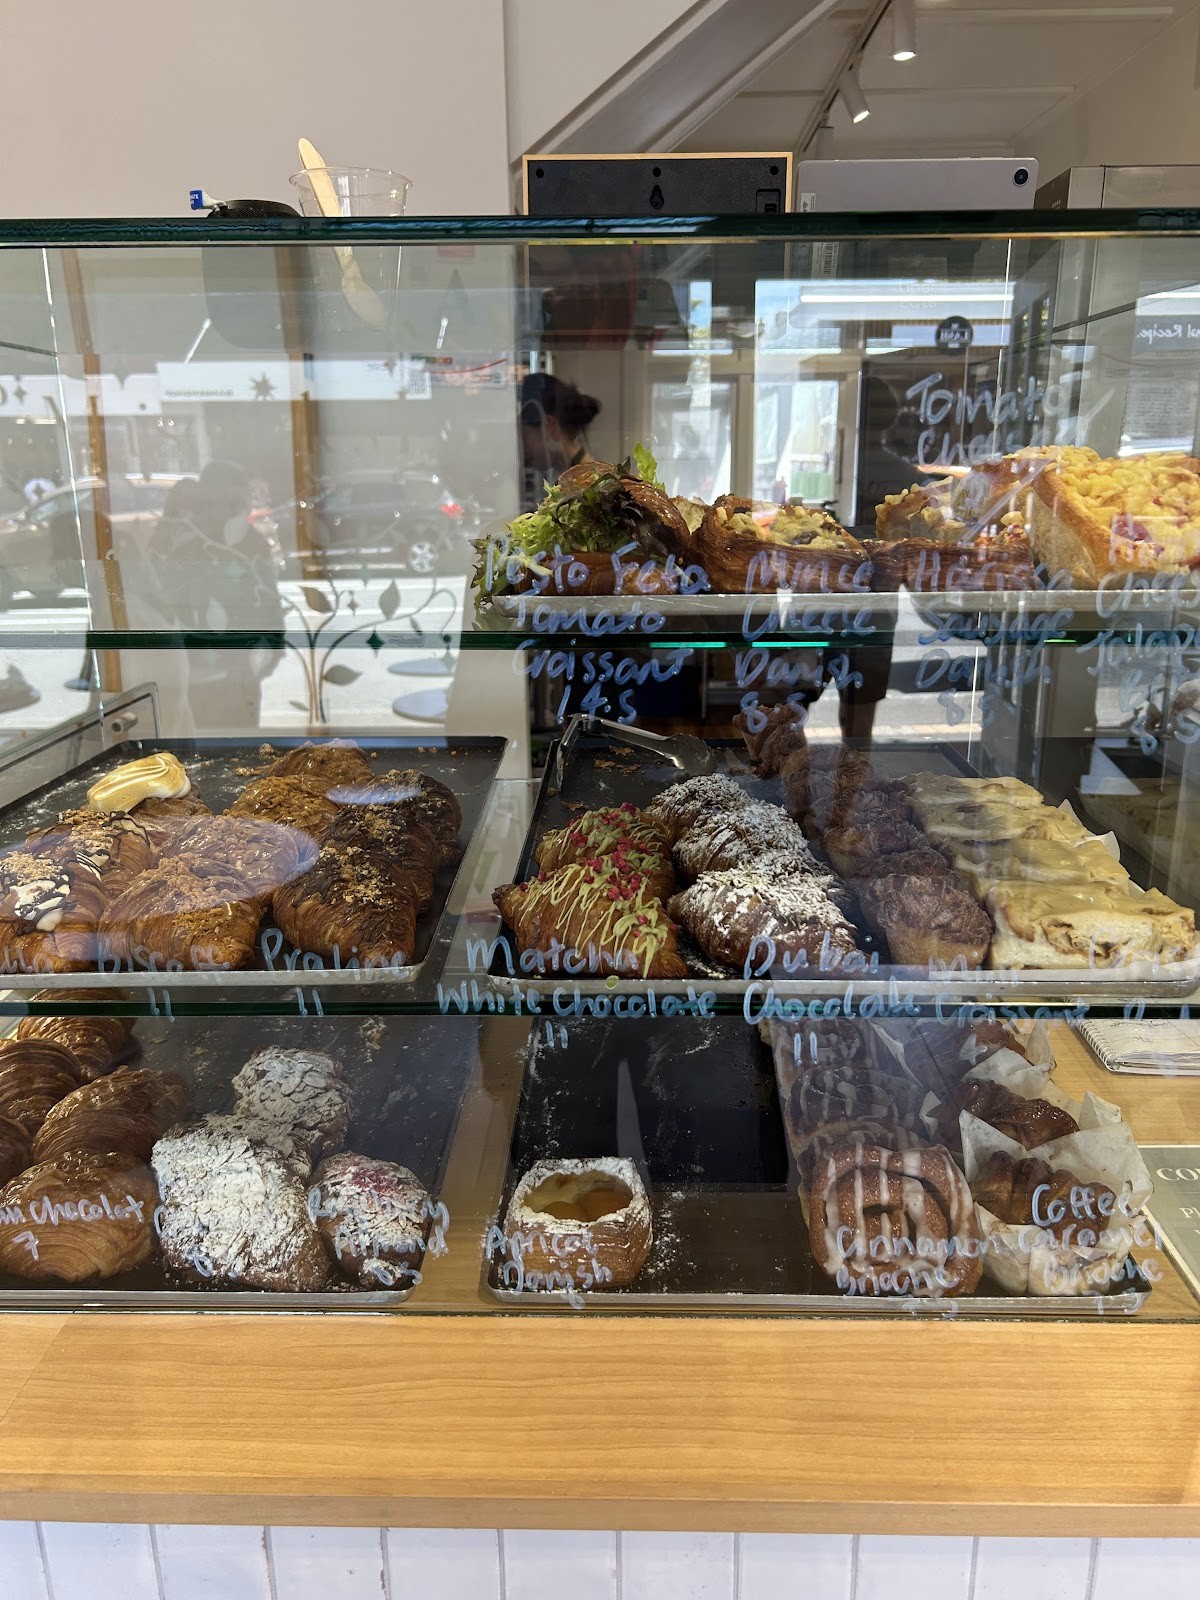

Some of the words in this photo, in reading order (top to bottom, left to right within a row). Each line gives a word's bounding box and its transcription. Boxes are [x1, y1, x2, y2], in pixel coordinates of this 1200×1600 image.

[504, 587, 666, 636] Tomato
[261, 928, 410, 982] Praline
[466, 937, 638, 975] Matcha
[438, 980, 541, 1016] White
[552, 984, 717, 1019] Chocolate
[1156, 1167, 1200, 1180] CO
[1032, 1184, 1140, 1228] Coffee
